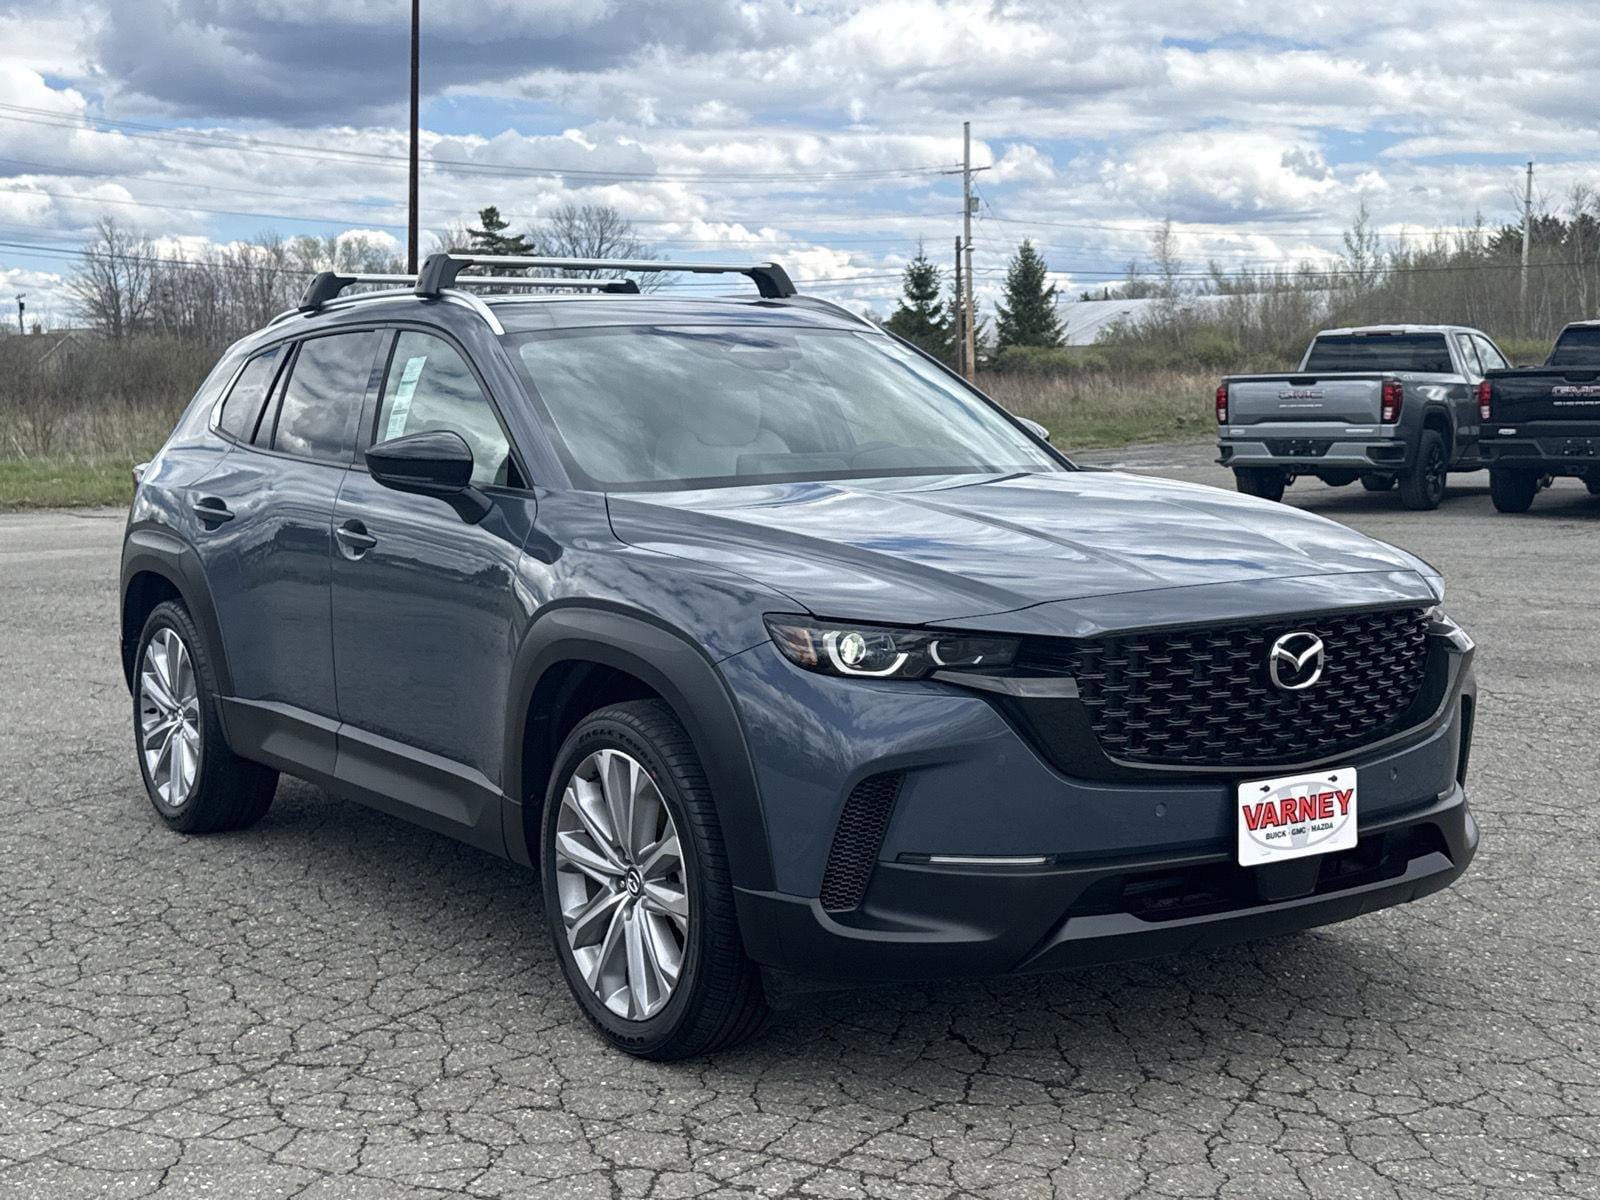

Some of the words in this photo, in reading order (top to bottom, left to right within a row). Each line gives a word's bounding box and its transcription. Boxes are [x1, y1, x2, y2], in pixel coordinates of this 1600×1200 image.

[1242, 788, 1354, 831] VARNEY
[1265, 830, 1287, 840] BUICK
[1291, 826, 1306, 836] GMC
[1311, 822, 1334, 832] MAZDA
